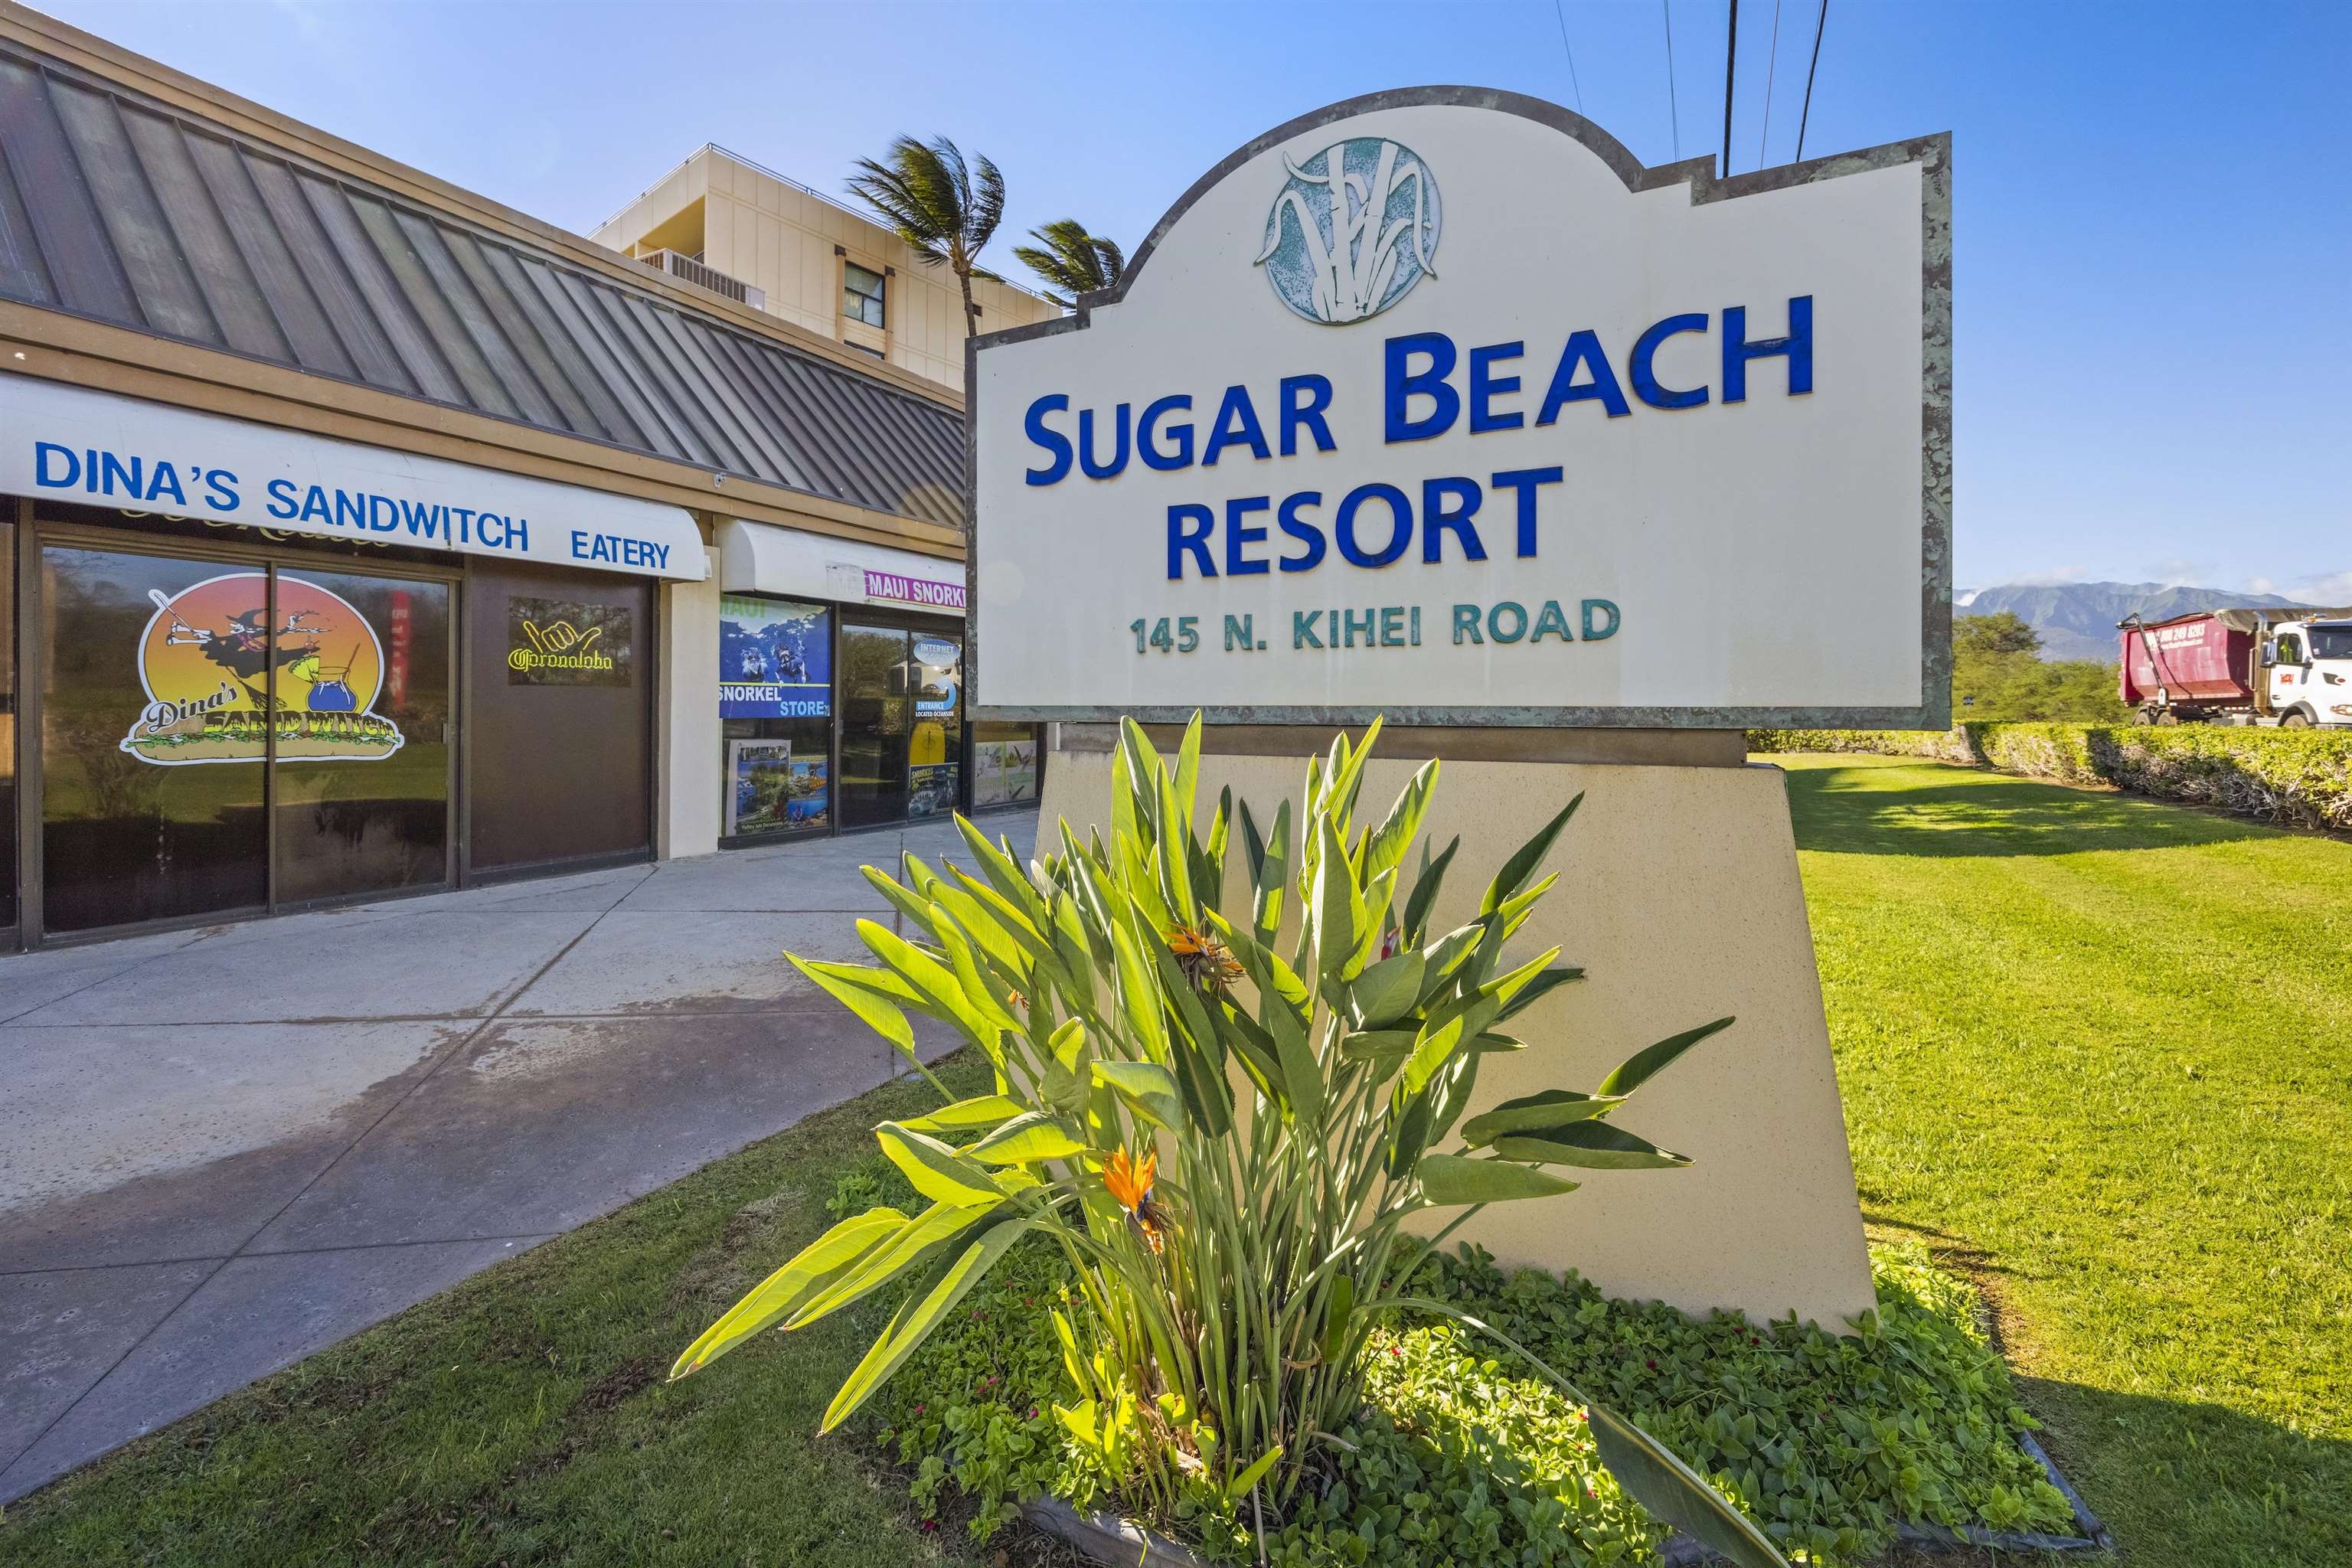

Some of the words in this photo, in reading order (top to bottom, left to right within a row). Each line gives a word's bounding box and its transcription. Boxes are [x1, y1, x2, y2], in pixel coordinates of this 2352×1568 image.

[1024, 374, 1337, 486] SUGAR
[1383, 296, 1814, 442] BEACH
[36, 441, 241, 512] DINA'S
[266, 479, 528, 552] SANDWITCH
[571, 530, 670, 569] EATERY
[1167, 466, 1563, 580] RESORT
[868, 573, 909, 599] MAUI
[1129, 616, 1200, 652] 145
[1224, 612, 1267, 650] N.
[1292, 605, 1422, 649] KIHEI
[1452, 599, 1622, 643] ROAD
[920, 643, 954, 653] INTERNET
[146, 681, 237, 733] Dina's
[718, 686, 782, 701] SNORKEL
[779, 701, 825, 716] STORE
[918, 701, 944, 710] ENTRANCE
